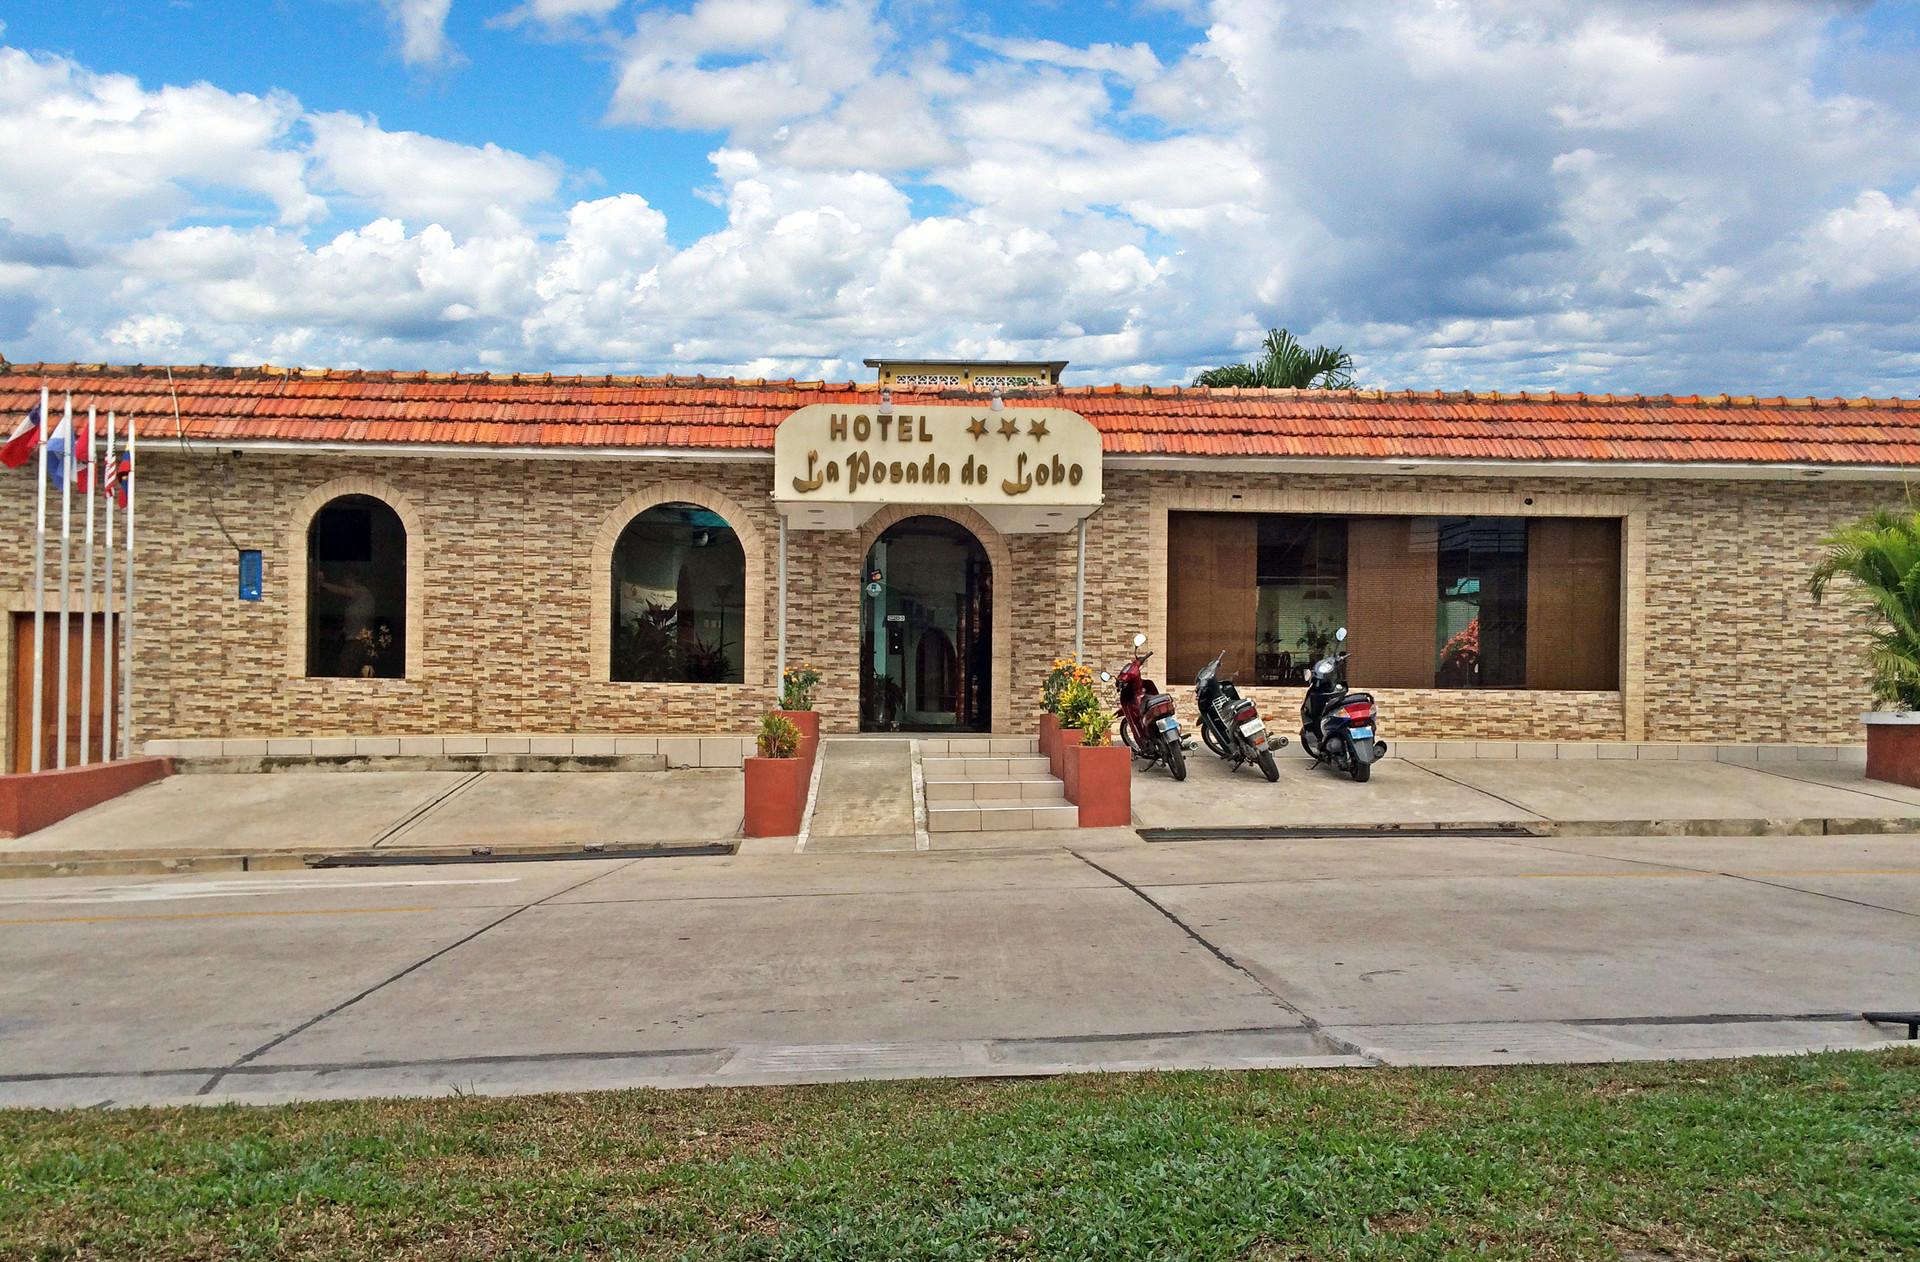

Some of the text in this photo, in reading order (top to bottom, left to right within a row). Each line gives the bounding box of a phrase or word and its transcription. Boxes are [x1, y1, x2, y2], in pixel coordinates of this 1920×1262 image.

[830, 413, 933, 442] HOTEL
[792, 449, 1083, 496] La Posada de Lobo
